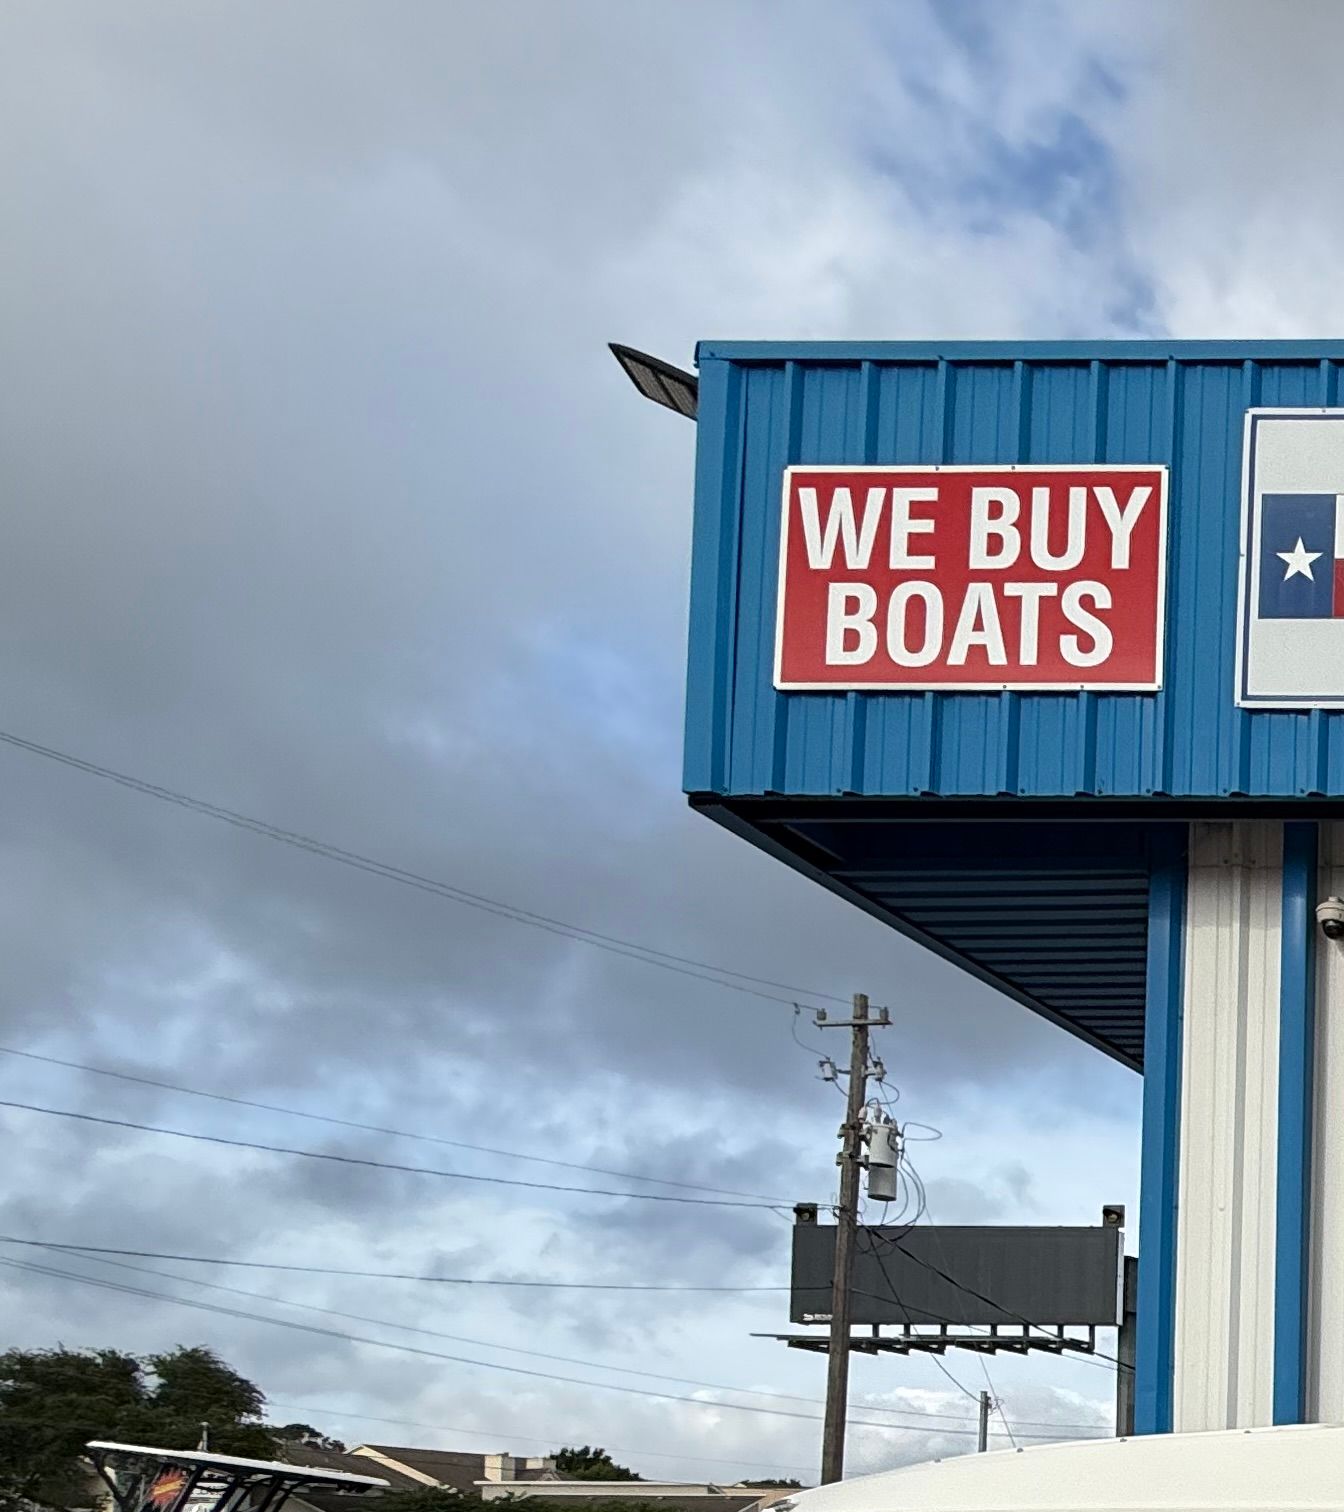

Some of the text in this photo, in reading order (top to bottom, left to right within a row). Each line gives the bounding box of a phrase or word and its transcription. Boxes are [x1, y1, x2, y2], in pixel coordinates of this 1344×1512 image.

[797, 486, 1153, 571] WE BUY
[825, 581, 1113, 667] BOATS
